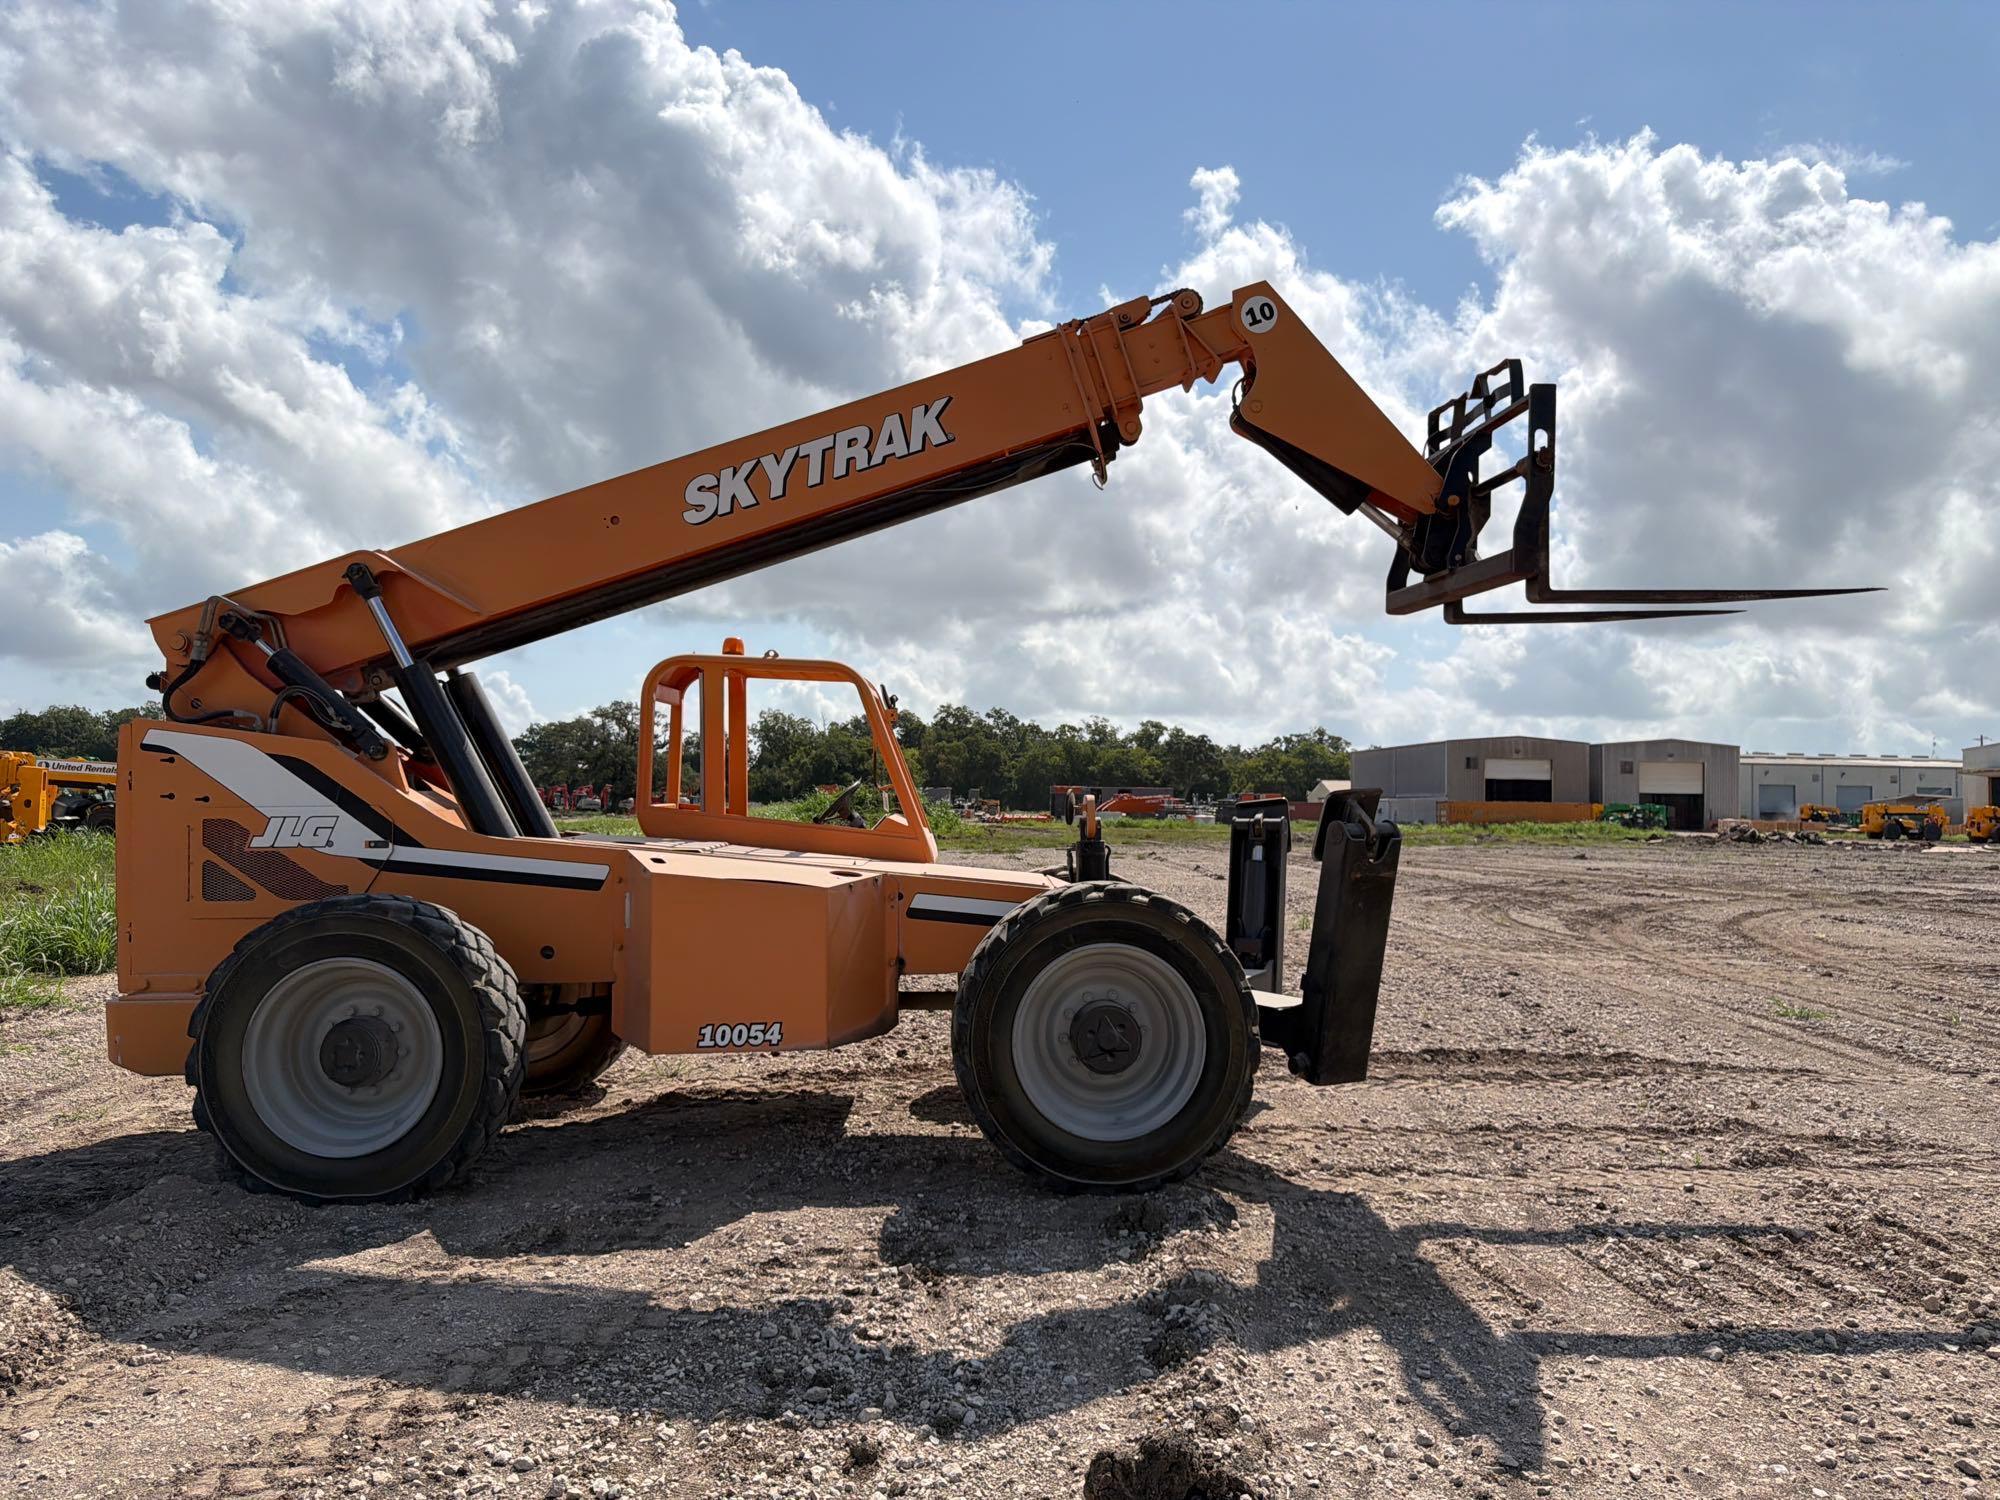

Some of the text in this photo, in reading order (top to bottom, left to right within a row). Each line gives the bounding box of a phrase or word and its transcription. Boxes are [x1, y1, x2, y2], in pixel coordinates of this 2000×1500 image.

[1245, 302, 1275, 327] 10
[682, 395, 954, 525] SKYTRAK
[52, 762, 83, 772] United
[248, 815, 339, 848] JLG
[697, 1021, 783, 1048] 10054
